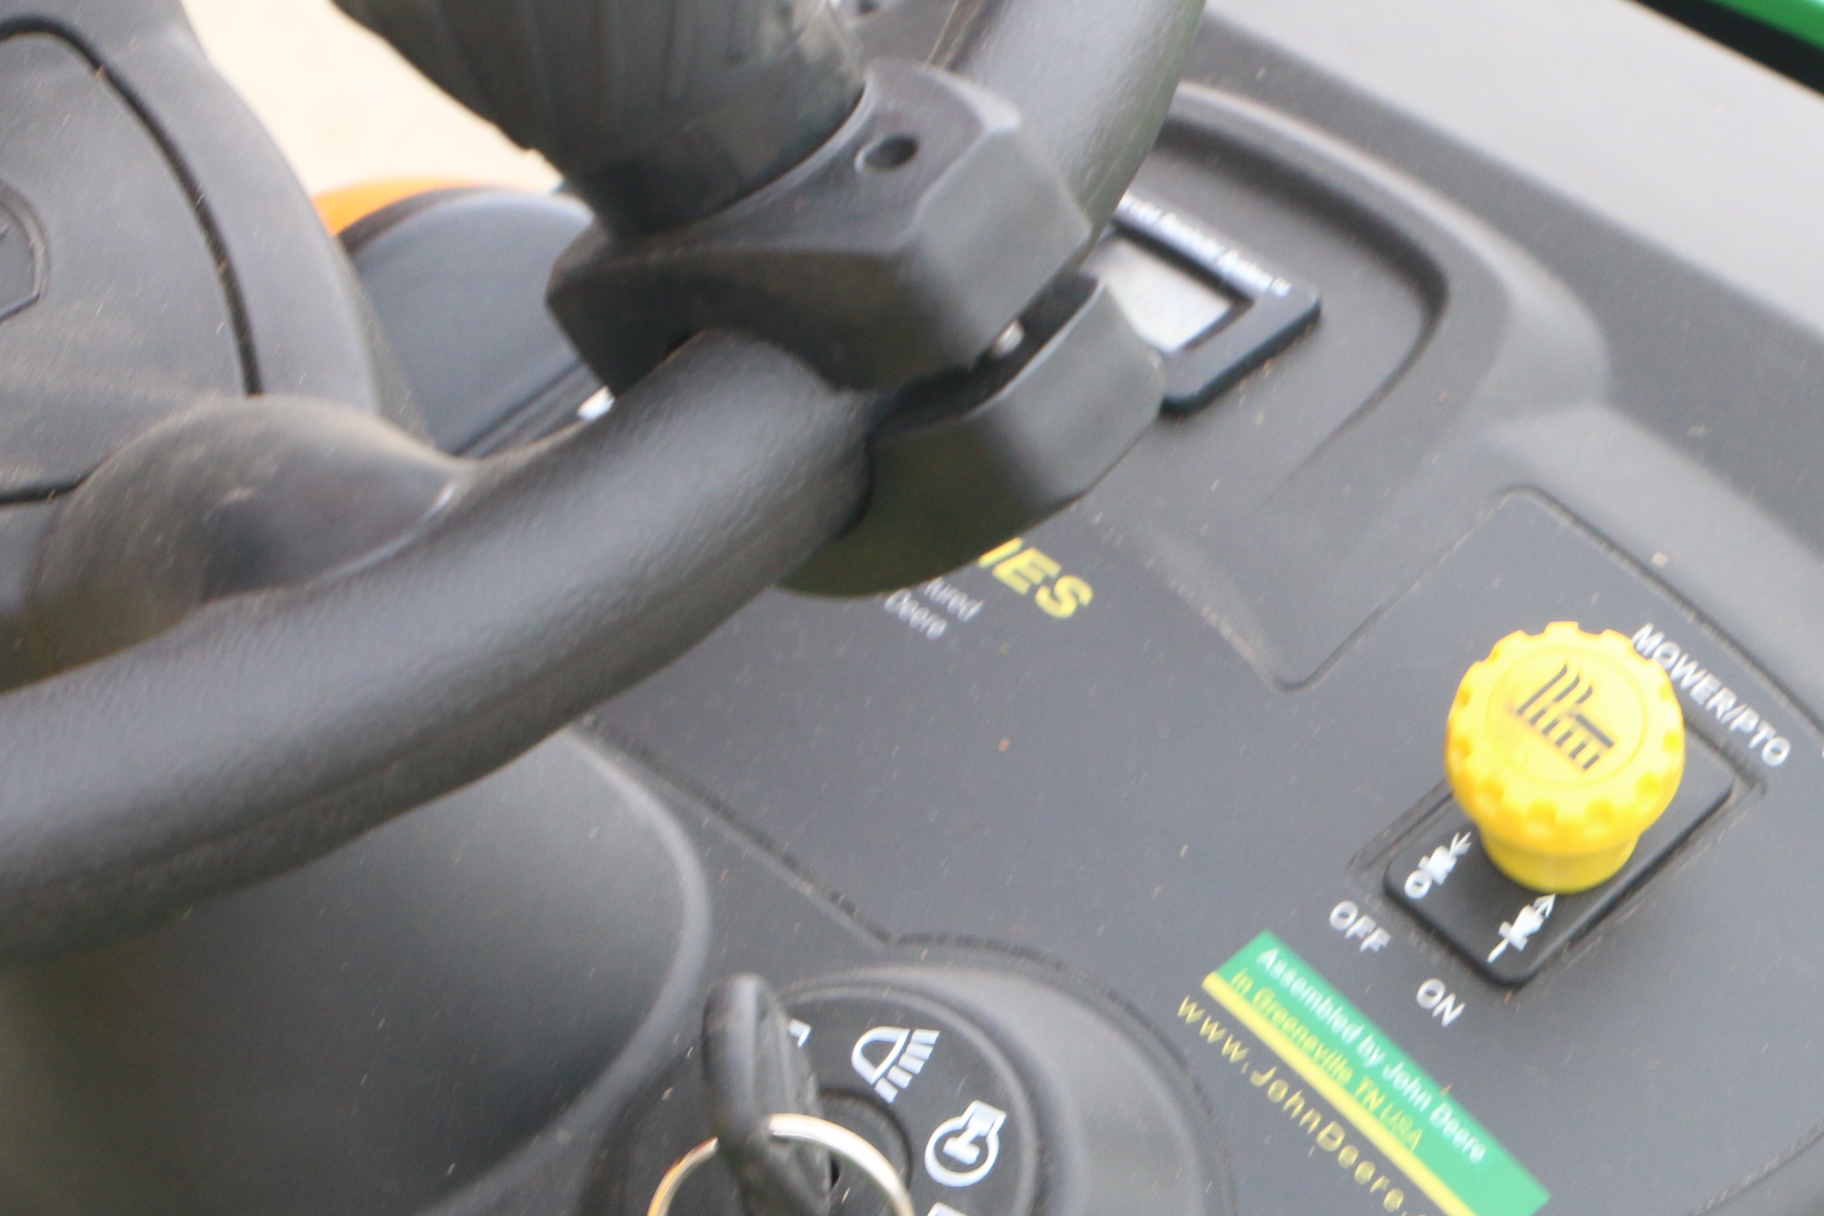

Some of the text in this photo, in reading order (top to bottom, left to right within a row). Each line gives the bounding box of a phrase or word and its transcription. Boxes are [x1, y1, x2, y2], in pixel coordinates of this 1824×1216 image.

[978, 537, 1093, 619] IES
[1632, 623, 1791, 767] MOWER/PTO
[1329, 901, 1391, 952] OFF
[1230, 967, 1424, 1152] in Greeneville TN USA
[1256, 946, 1487, 1165] Assembled by John Deere
[1416, 978, 1466, 1028] ON
